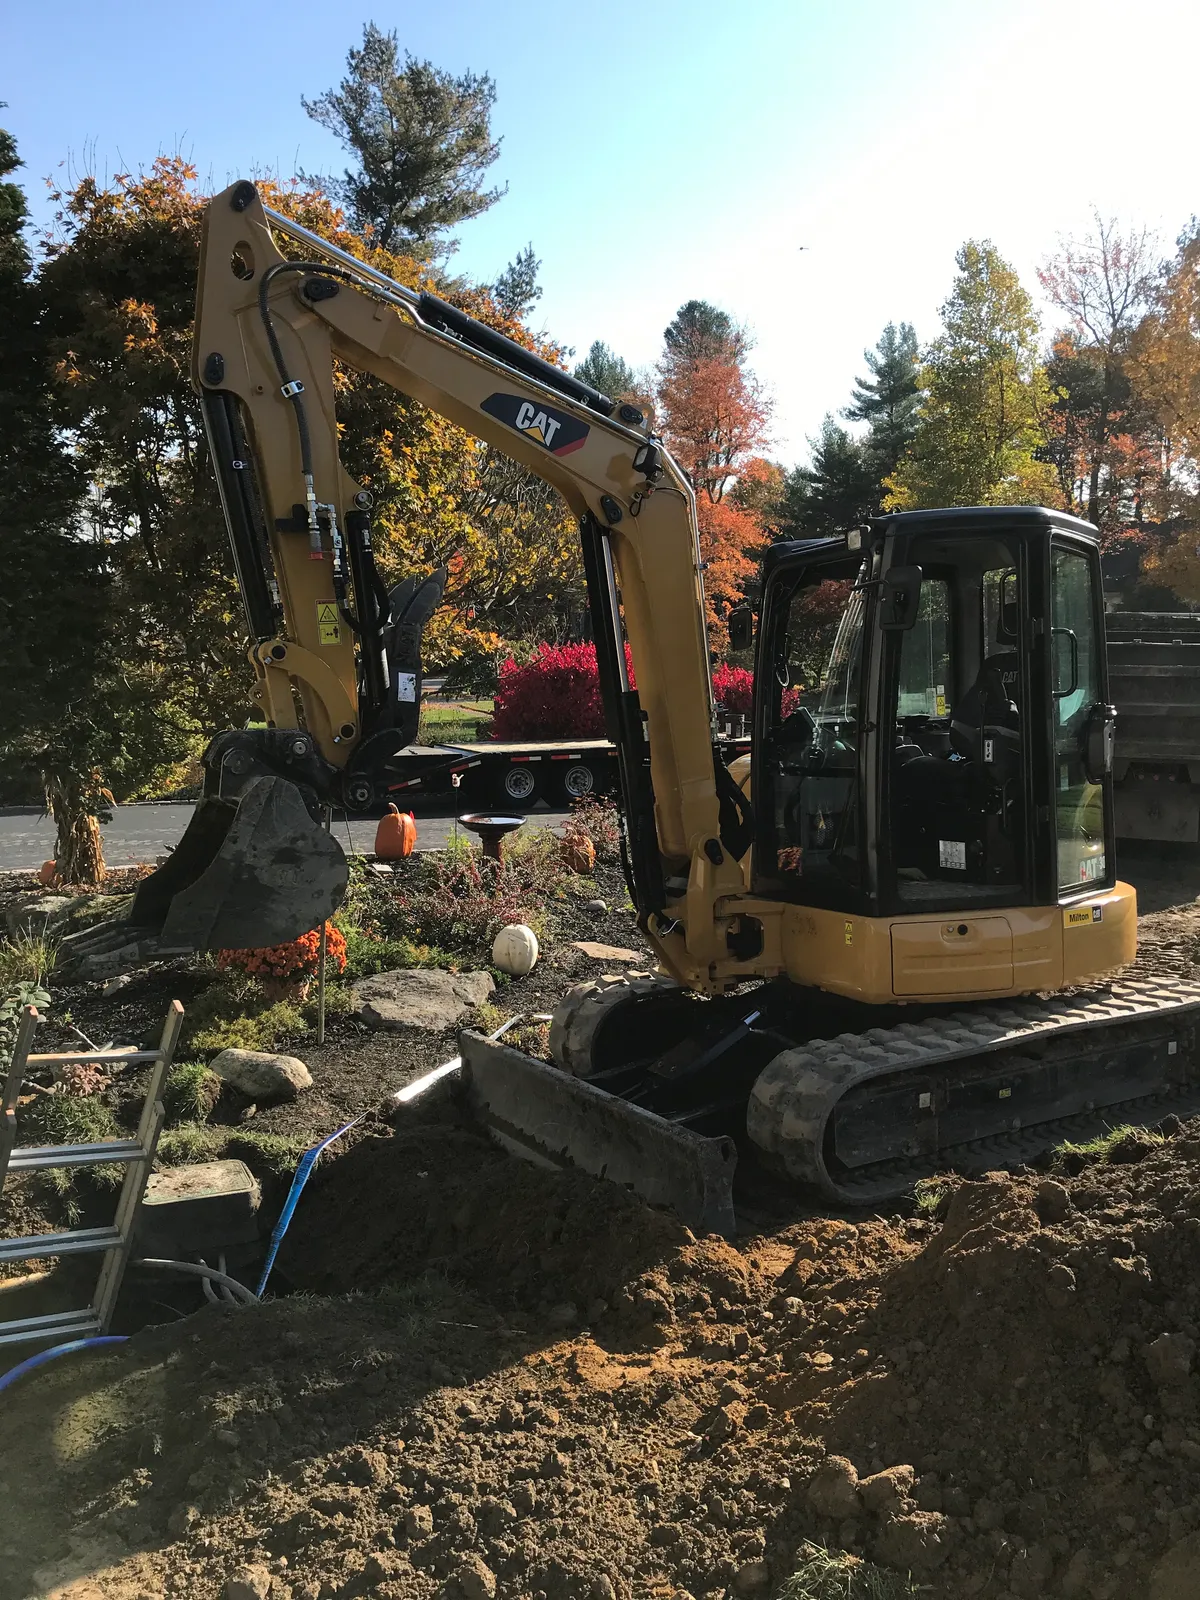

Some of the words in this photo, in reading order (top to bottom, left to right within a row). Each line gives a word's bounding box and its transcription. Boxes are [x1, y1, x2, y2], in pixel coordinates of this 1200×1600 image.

[515, 401, 561, 447] CAT
[1002, 671, 1019, 683] CAT
[1069, 913, 1090, 922] Milton
